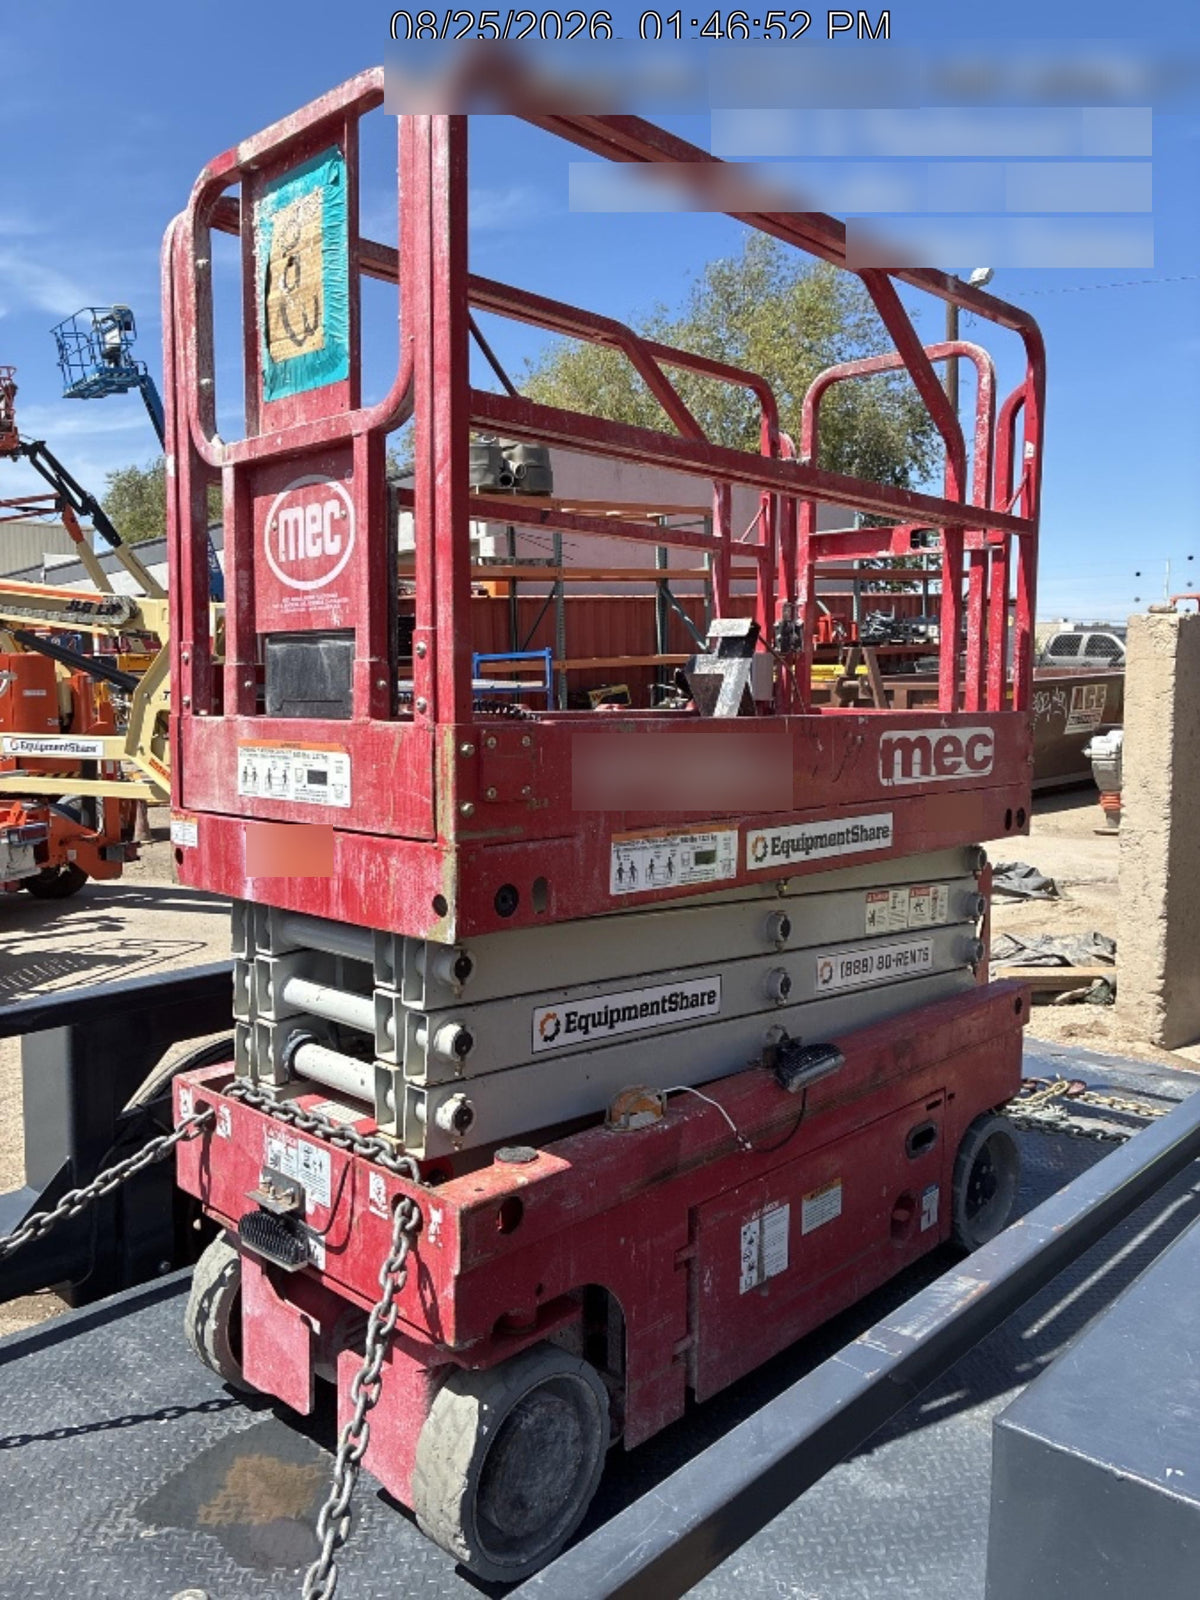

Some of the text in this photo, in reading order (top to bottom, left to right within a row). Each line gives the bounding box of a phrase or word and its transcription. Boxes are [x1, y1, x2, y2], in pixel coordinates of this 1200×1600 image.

[278, 499, 342, 562] mec
[20, 740, 97, 753] EquipmentShare
[878, 733, 993, 779] mec
[771, 824, 890, 858] EquipmentShare
[840, 947, 930, 979] (888) 80-RENTS
[564, 989, 717, 1035] EquipmentShare
